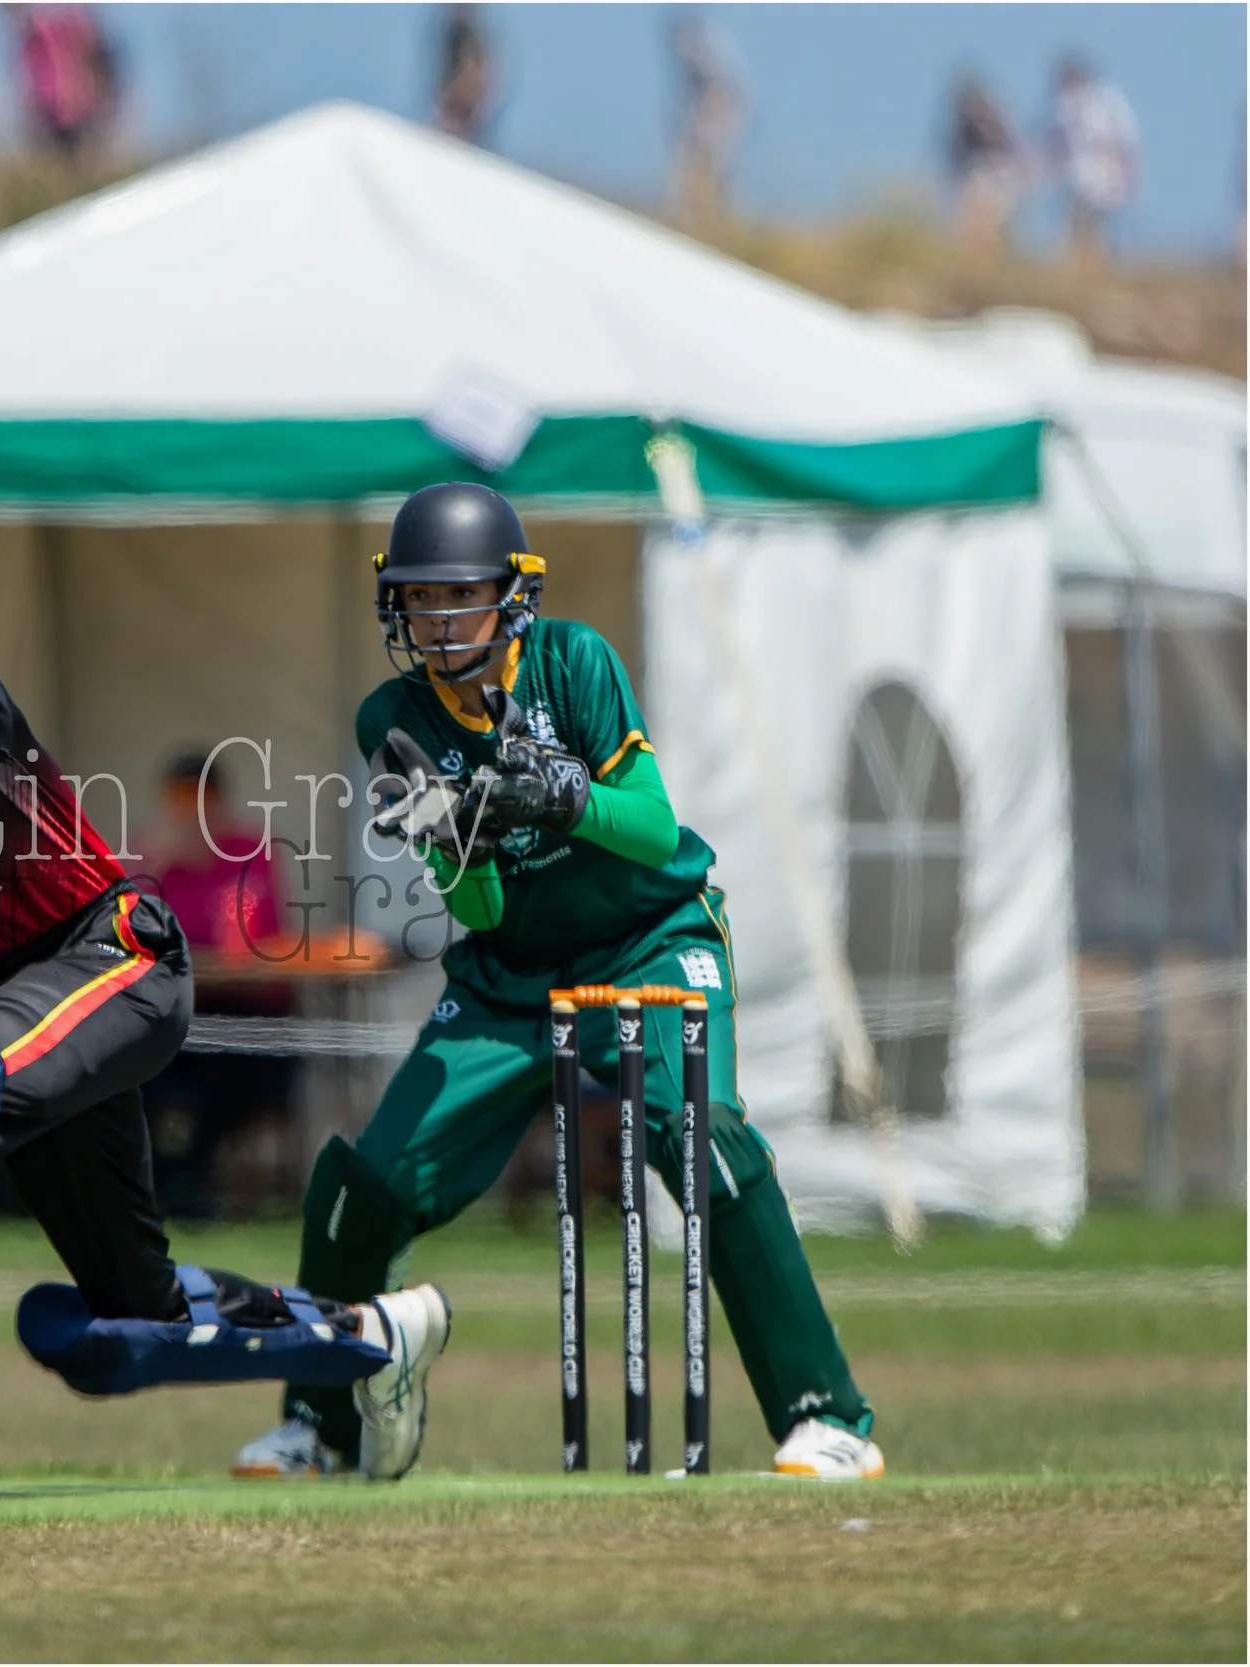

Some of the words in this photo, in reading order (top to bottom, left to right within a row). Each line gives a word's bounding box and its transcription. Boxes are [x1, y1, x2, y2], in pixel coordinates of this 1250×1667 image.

[621, 1099, 633, 1129] ICC
[683, 1101, 695, 1130] ICC
[621, 1159, 635, 1210] MEN'S
[560, 1214, 576, 1293] CRICKET
[626, 1211, 643, 1288] CRICKET
[687, 1214, 702, 1289] CRICKET
[563, 1293, 577, 1357] WORLD
[628, 1288, 644, 1355] WORLD
[688, 1289, 704, 1357] WORLD
[628, 1355, 646, 1397] CUP
[688, 1358, 705, 1398] CUP
